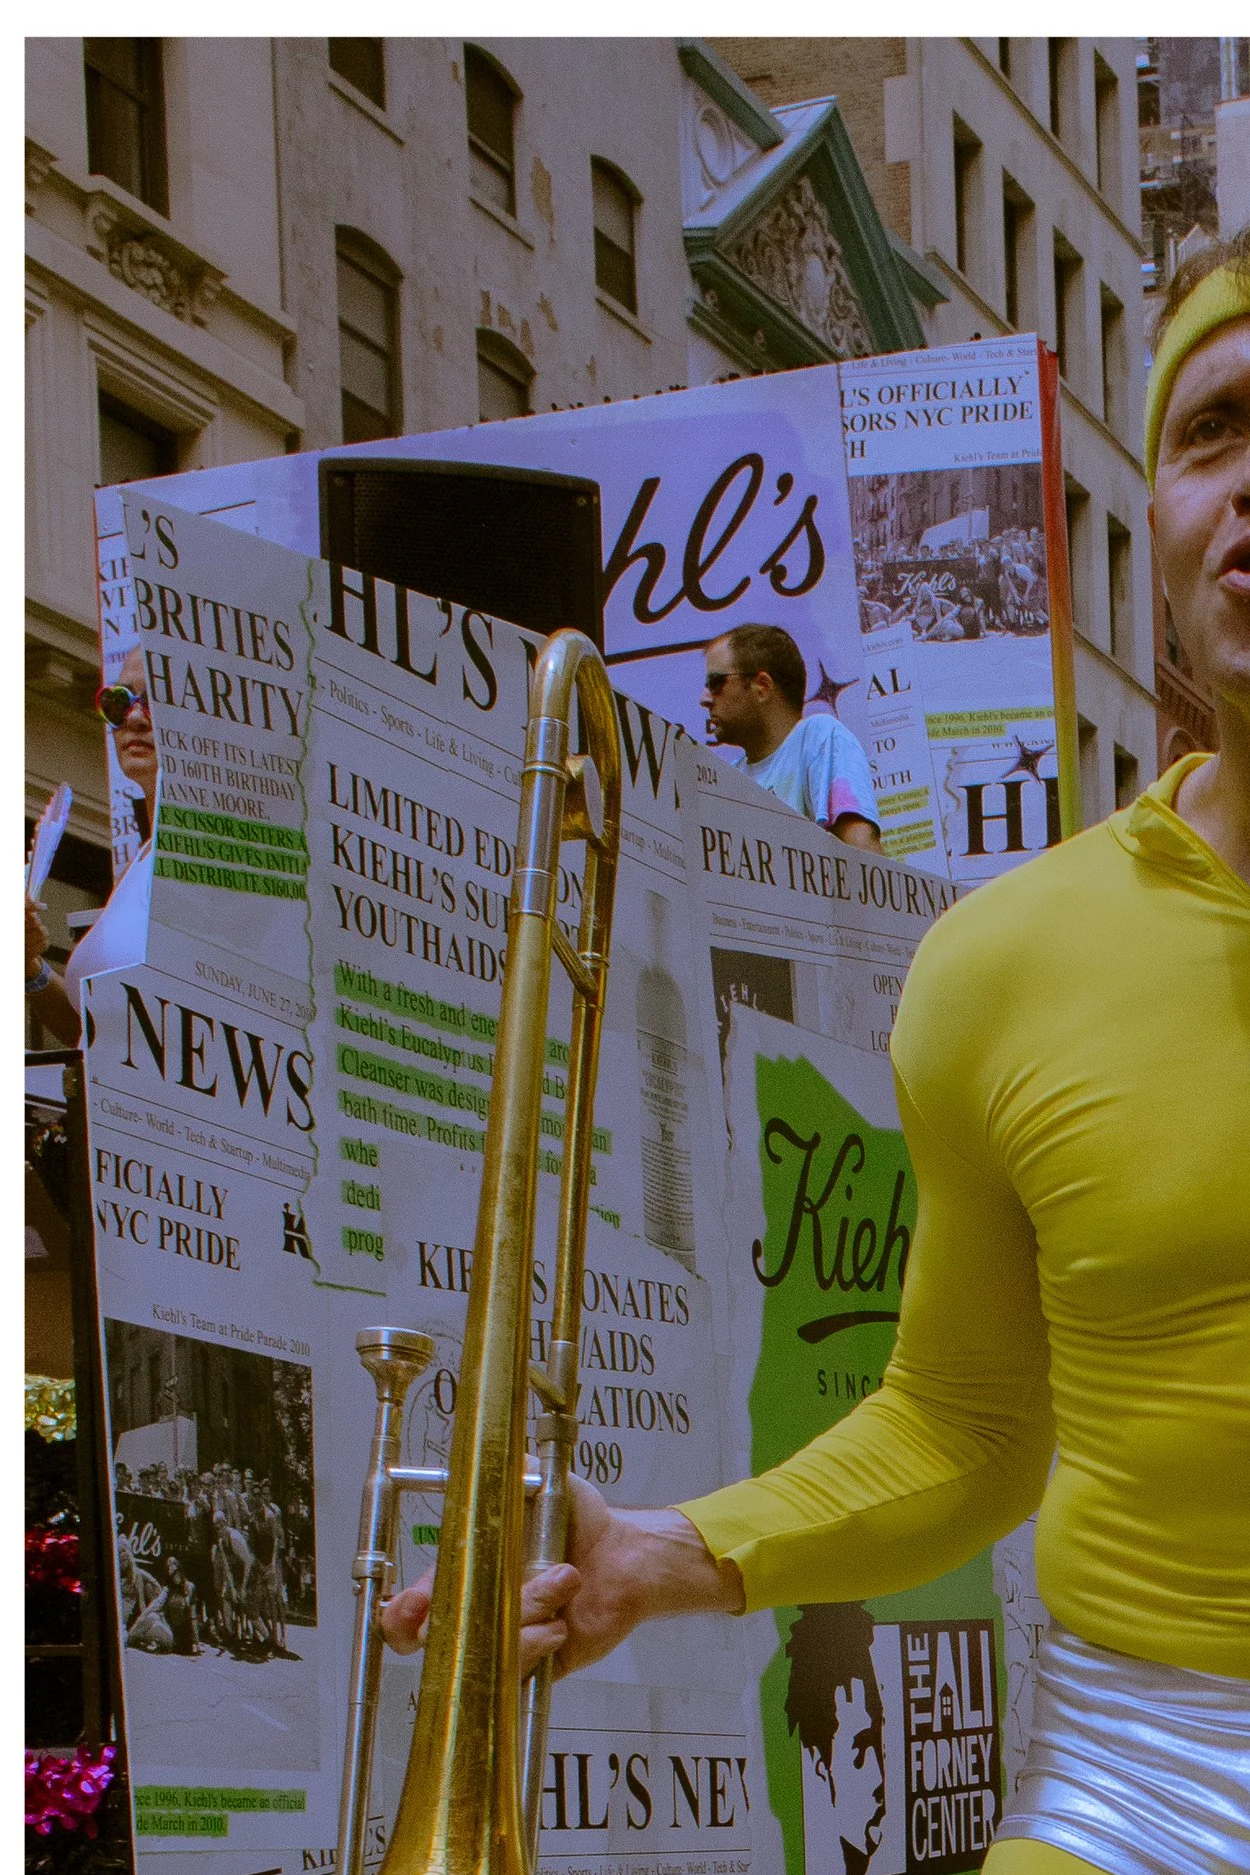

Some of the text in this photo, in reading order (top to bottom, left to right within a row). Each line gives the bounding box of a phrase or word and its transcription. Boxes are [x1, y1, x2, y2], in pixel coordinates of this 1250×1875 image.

[877, 375, 1020, 404] OFFICIALLY
[904, 407, 953, 430] NYC
[961, 400, 1034, 425] PRIDE
[987, 450, 1008, 461] Team
[133, 577, 295, 672] BRITIES
[145, 650, 303, 737] HARITY
[866, 667, 911, 701] AL
[329, 678, 370, 716] Politics
[380, 704, 414, 738] Sports
[425, 727, 447, 753] Life
[449, 739, 459, 758] &
[462, 742, 495, 779] Living
[942, 724, 969, 737] March
[1000, 710, 1032, 722] became
[192, 735, 220, 760] OFF
[224, 742, 247, 768] ITS
[250, 749, 302, 778] LATEST
[872, 737, 896, 755] TO
[182, 759, 297, 801] 160TH BIRTHDAY
[697, 764, 718, 786] 2024
[174, 808, 236, 839] SCISSOR
[238, 820, 295, 851] SISTERS
[327, 761, 465, 859] LIMITED
[175, 862, 260, 894] DISTRIBUTE
[218, 842, 263, 869] GIVES
[330, 822, 456, 914] KIEHL'S
[700, 826, 777, 887] PEAR
[782, 846, 851, 900] TREE
[195, 961, 245, 997] SUNDAY,
[248, 982, 277, 1008] JUNE
[338, 958, 379, 998] With
[396, 980, 435, 1018] fresh
[440, 1003, 466, 1027] and
[120, 981, 316, 1133] NEWS
[339, 1003, 397, 1047] Kiehl's
[401, 1024, 484, 1074] Eucalyptus
[341, 1048, 411, 1093] Cleanser
[414, 1078, 444, 1104] was
[147, 1111, 175, 1137] World
[185, 1126, 206, 1146] Tech
[208, 1134, 218, 1149] &
[222, 1136, 253, 1166] Startup
[343, 1090, 477, 1151] bath time. Profits
[345, 1137, 379, 1168] whe
[95, 1147, 229, 1221] FICIALLY
[346, 1179, 381, 1212] dedi
[96, 1199, 241, 1272] NYC PRIDE
[348, 1229, 385, 1262] prog
[581, 1269, 690, 1327] ONATES
[152, 1304, 188, 1326] Kiehl's
[190, 1313, 216, 1335] Team
[219, 1322, 228, 1336] at
[230, 1323, 255, 1345] Pride
[257, 1330, 288, 1351] Parade
[907, 1630, 993, 1736] THE ALI
[911, 1733, 994, 1793] FORNEY
[151, 1816, 185, 1832] March
[188, 1815, 198, 1832] in
[184, 1791, 219, 1808] Kiehl's
[222, 1792, 259, 1809] became
[912, 1789, 997, 1862] CENTER
